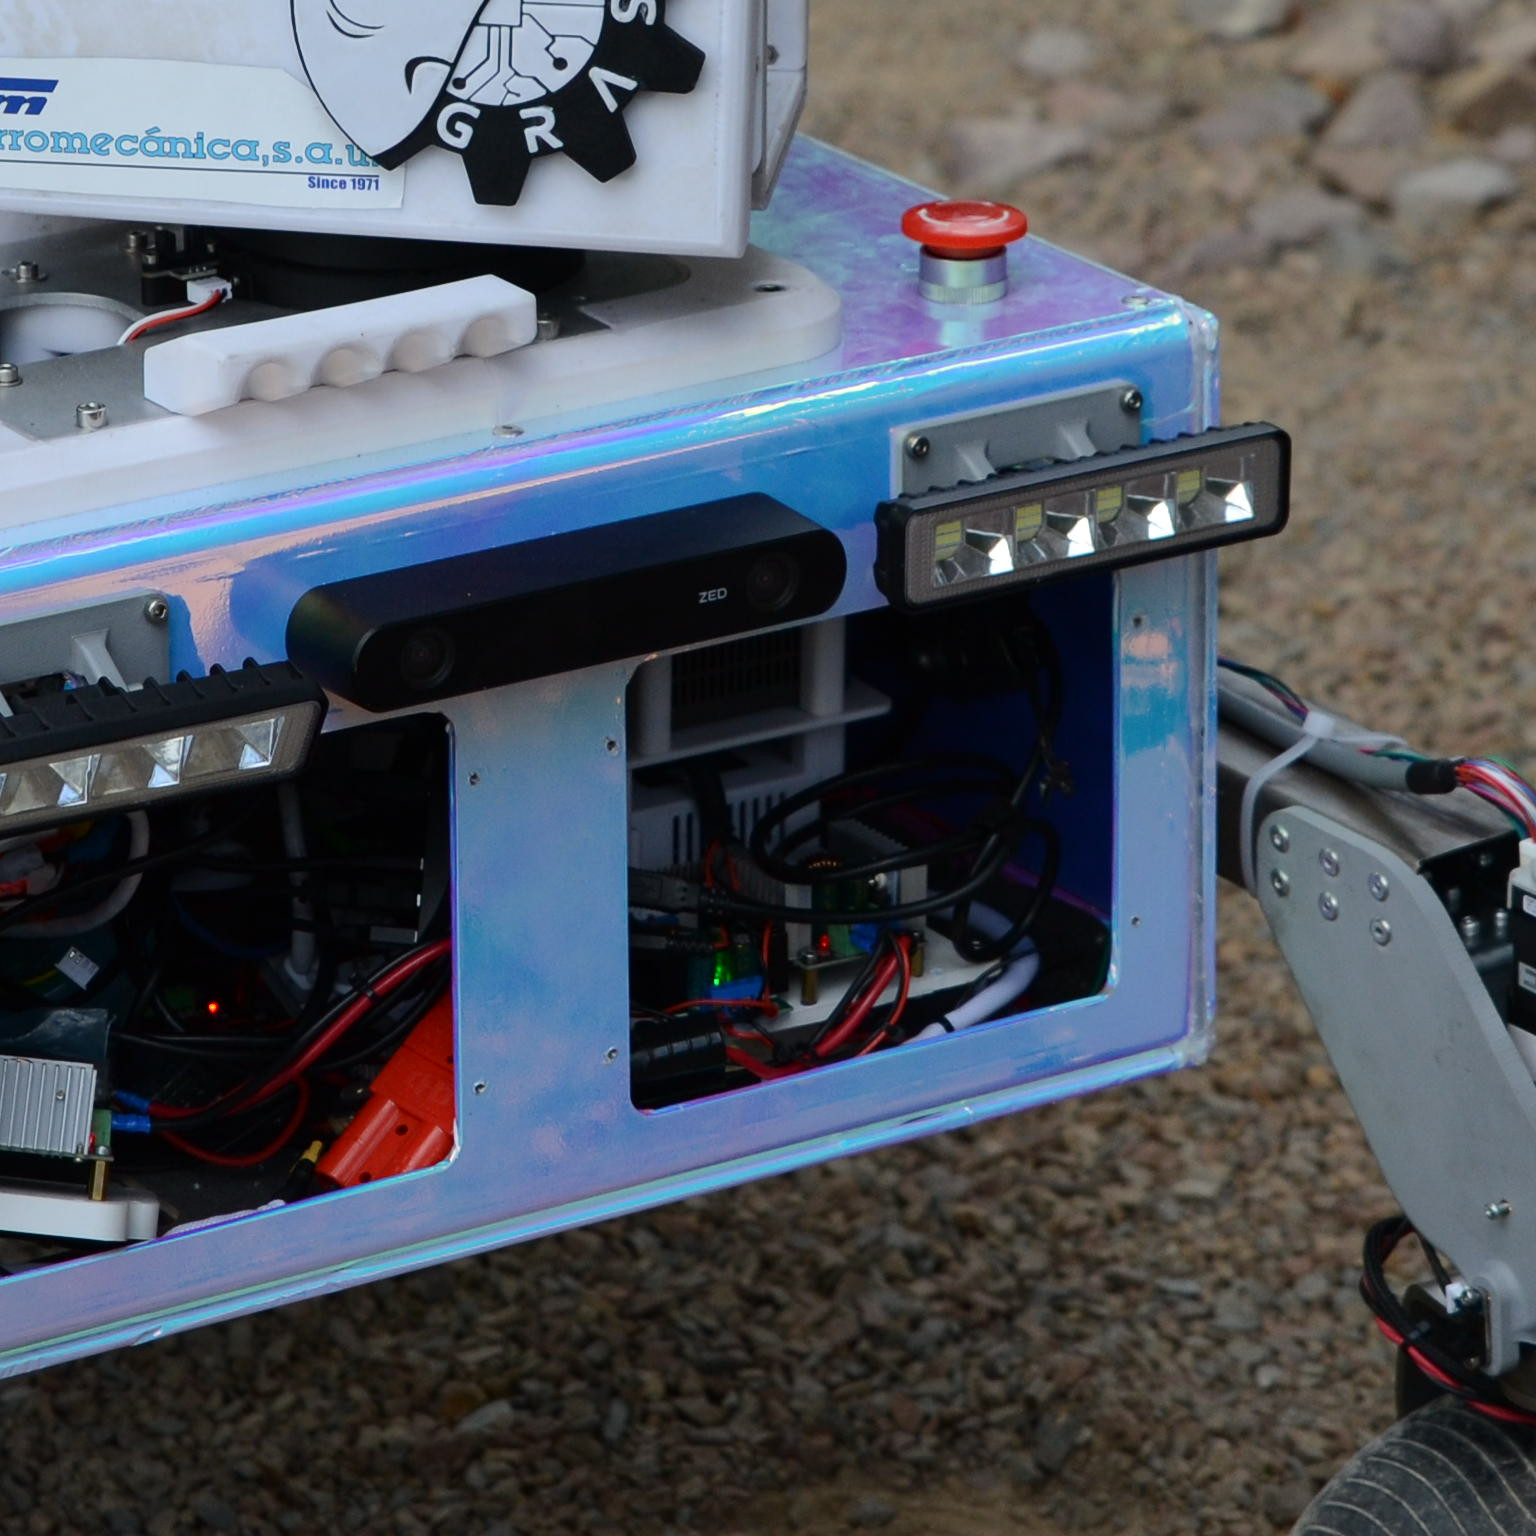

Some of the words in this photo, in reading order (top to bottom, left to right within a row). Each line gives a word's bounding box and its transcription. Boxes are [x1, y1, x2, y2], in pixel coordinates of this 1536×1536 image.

[307, 174, 347, 190] Since
[351, 177, 380, 192] 1971
[698, 587, 728, 604] ZED
